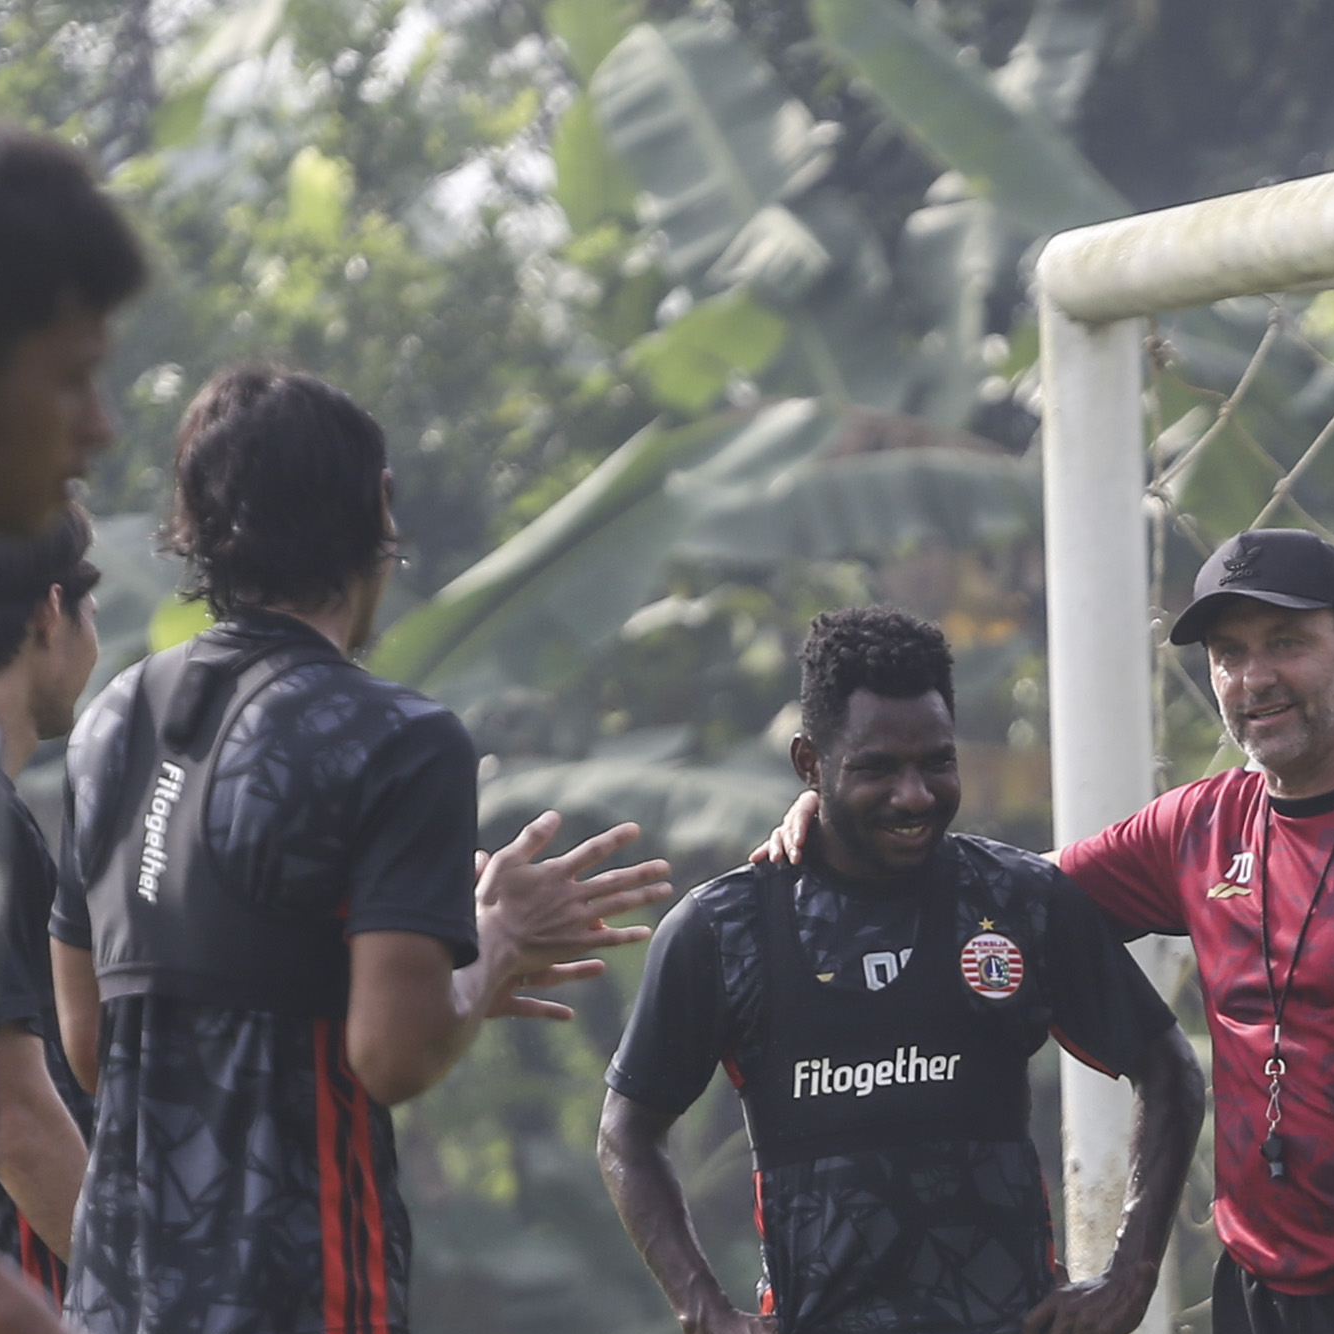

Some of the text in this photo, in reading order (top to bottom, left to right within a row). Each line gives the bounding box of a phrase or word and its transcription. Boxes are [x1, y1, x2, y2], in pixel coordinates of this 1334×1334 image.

[137, 761, 186, 905] Fitogether
[972, 940, 1009, 948] PERSIJA
[793, 1045, 961, 1099] Fitogether
